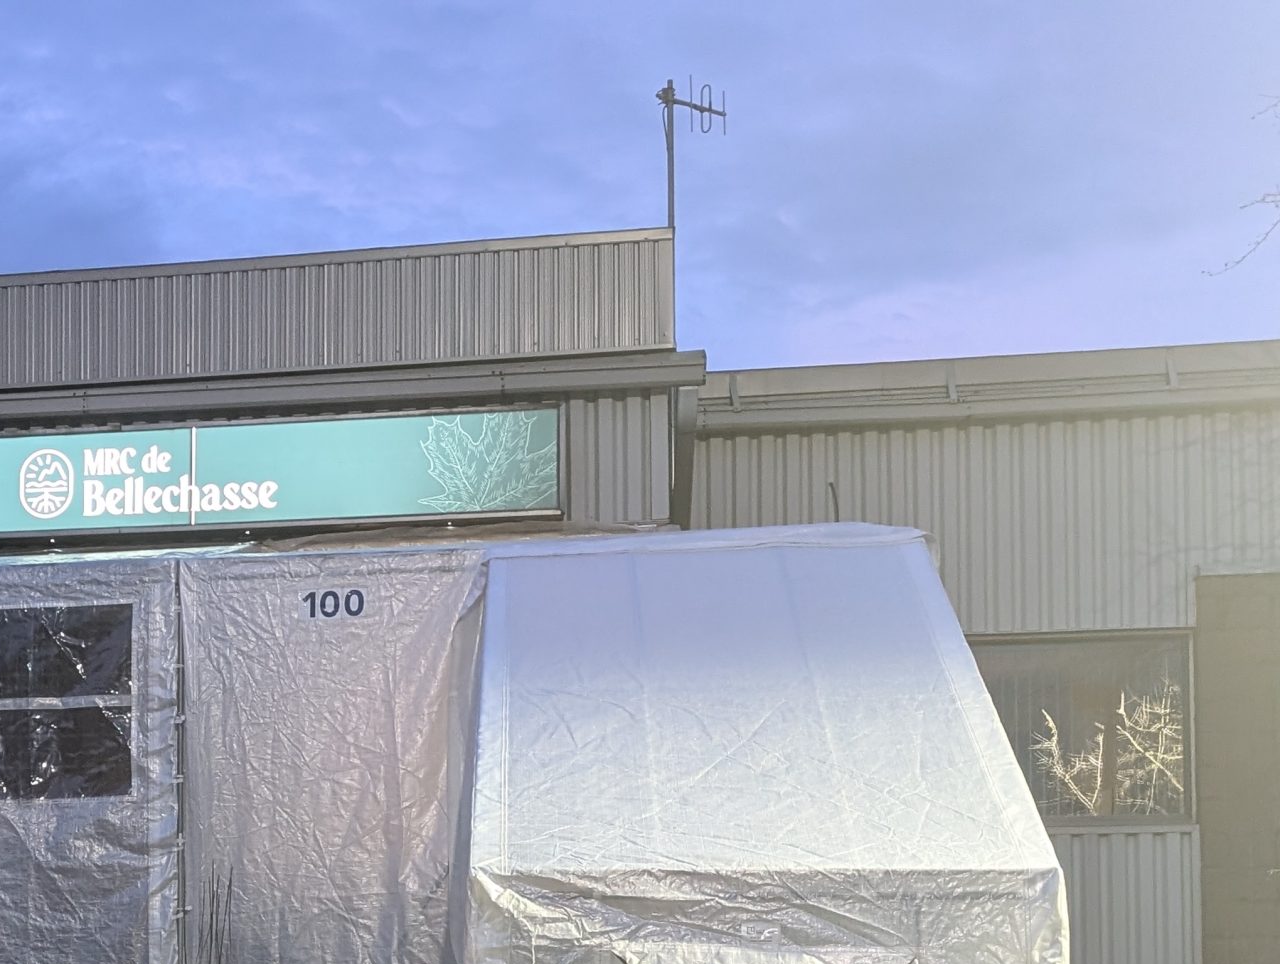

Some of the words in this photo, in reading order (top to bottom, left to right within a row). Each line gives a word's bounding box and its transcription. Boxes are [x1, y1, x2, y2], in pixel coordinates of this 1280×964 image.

[83, 448, 136, 476] MRC
[141, 444, 172, 474] de
[83, 474, 279, 517] Bellechasse
[302, 589, 364, 618] 100
